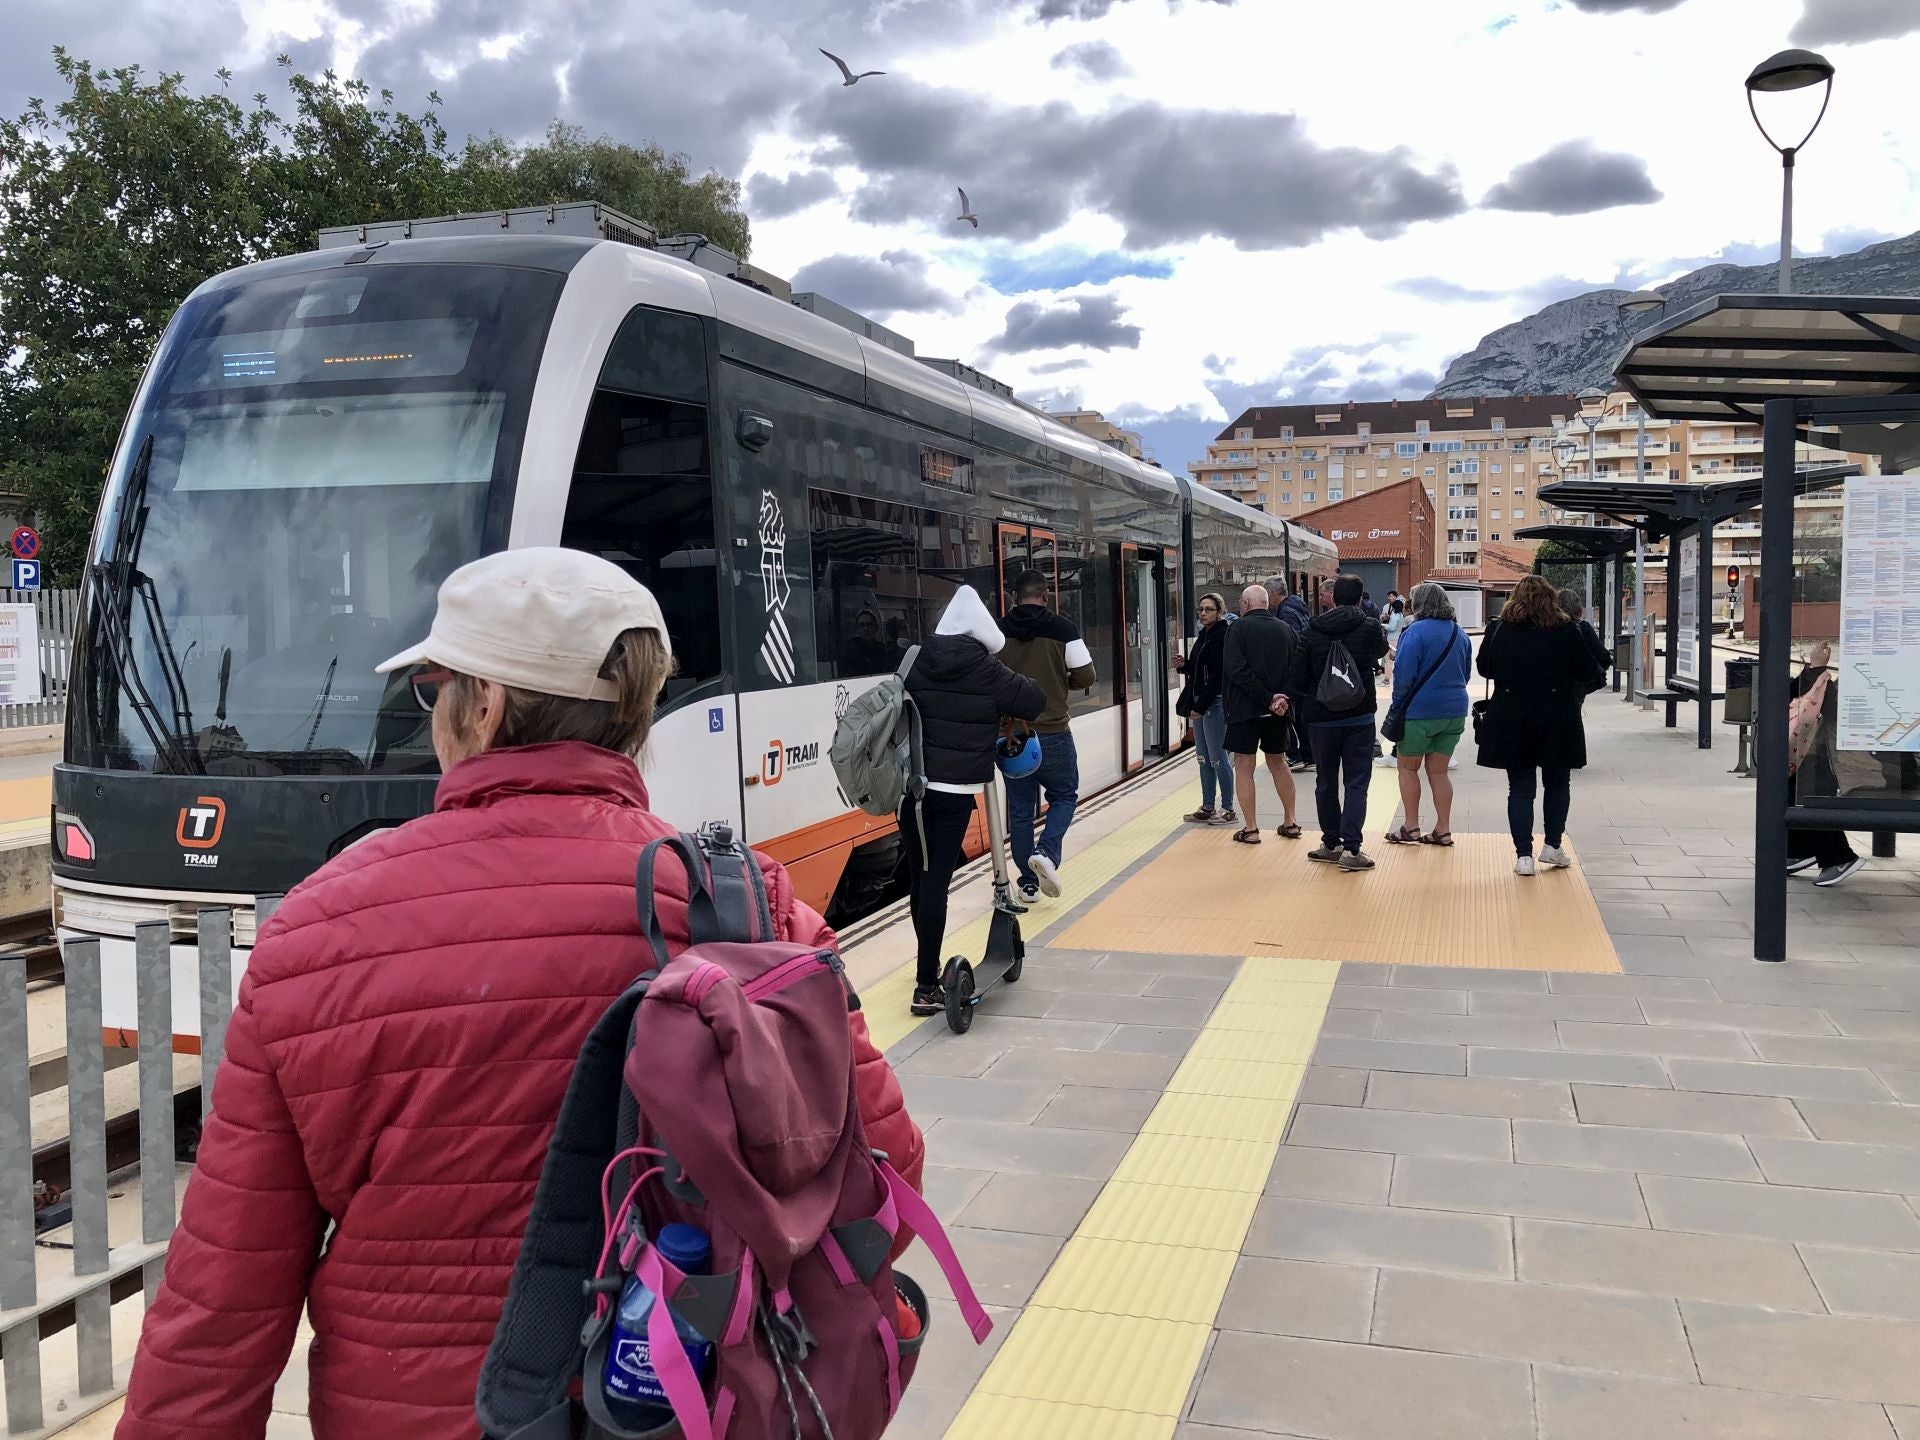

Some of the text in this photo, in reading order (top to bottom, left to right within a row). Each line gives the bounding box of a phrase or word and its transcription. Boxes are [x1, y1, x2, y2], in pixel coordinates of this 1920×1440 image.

[18, 563, 36, 588] P
[785, 741, 819, 765] TRAM
[183, 853, 219, 865] TRAM
